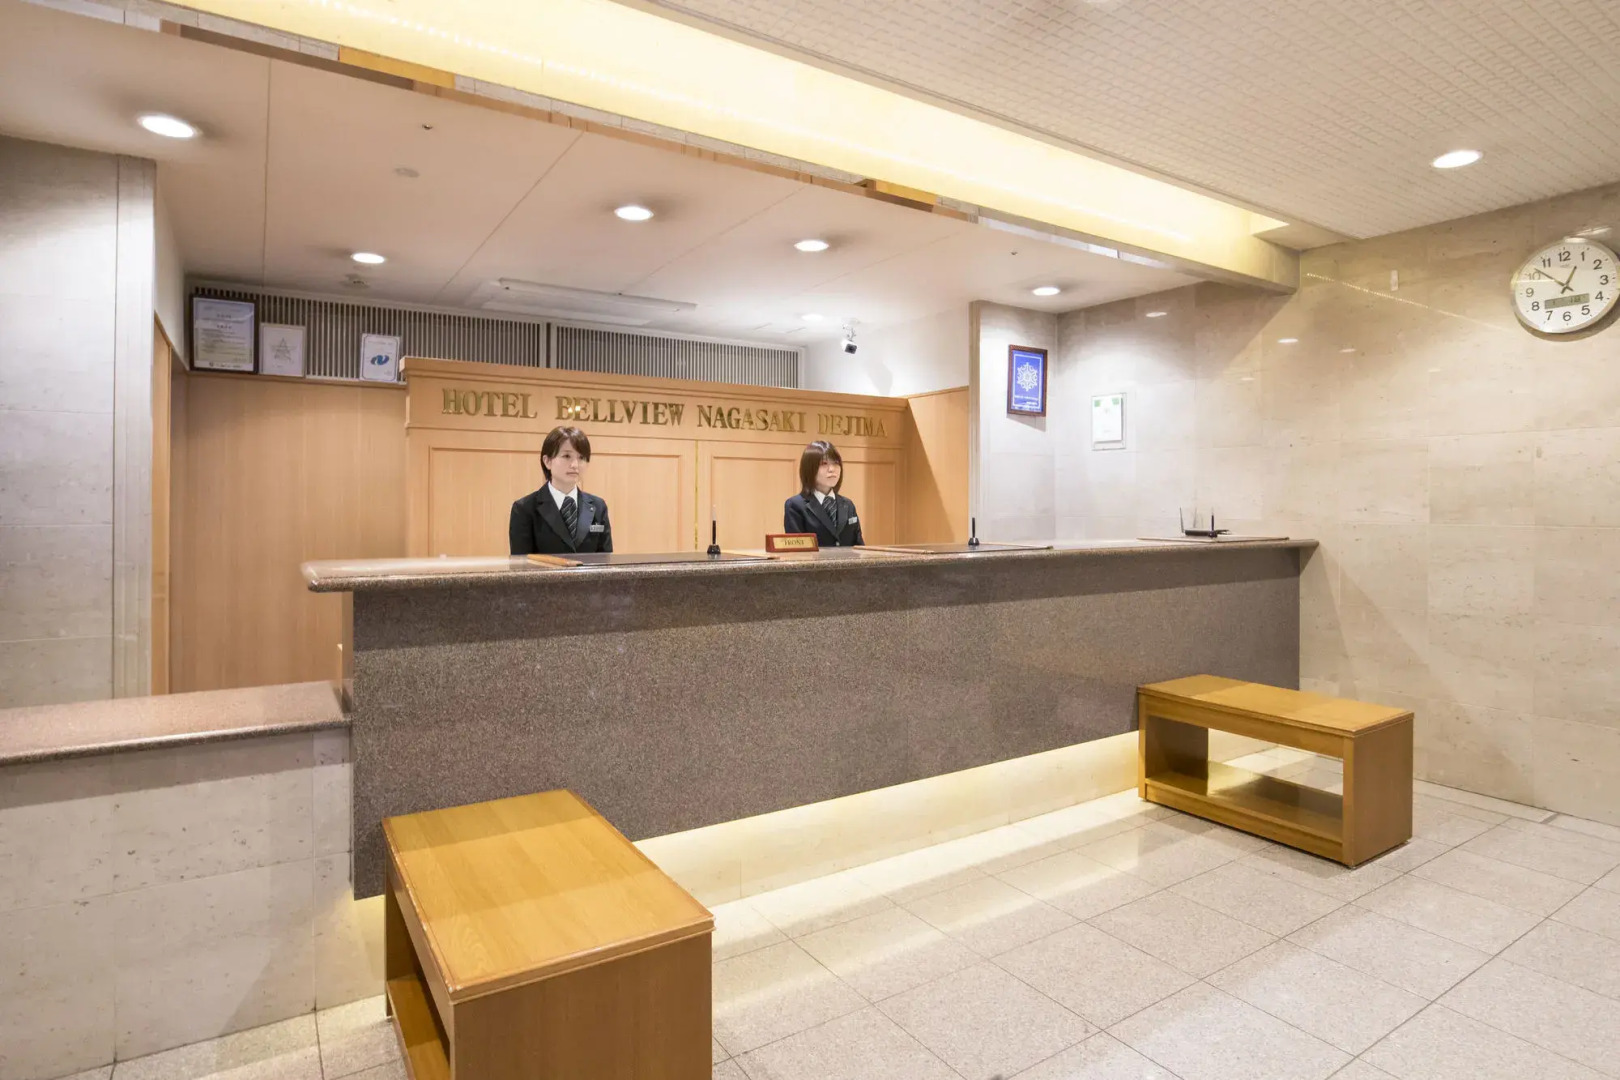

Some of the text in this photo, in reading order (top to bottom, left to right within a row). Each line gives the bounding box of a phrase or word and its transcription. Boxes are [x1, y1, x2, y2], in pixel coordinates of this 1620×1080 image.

[1558, 250, 1571, 262] 12
[1581, 251, 1585, 262] 1
[1542, 257, 1551, 268] 11
[1593, 259, 1602, 270] 2
[1528, 271, 1541, 281] 10
[1600, 274, 1609, 285] 3
[1526, 287, 1535, 298] 9
[1595, 291, 1604, 301] 4
[1531, 301, 1540, 311] 8
[1581, 305, 1590, 315] 5
[1545, 310, 1553, 321] 7
[1562, 311, 1571, 321] 6
[441, 387, 888, 438] HOTEL BELLVIEW NAGASAKI DEJIMA
